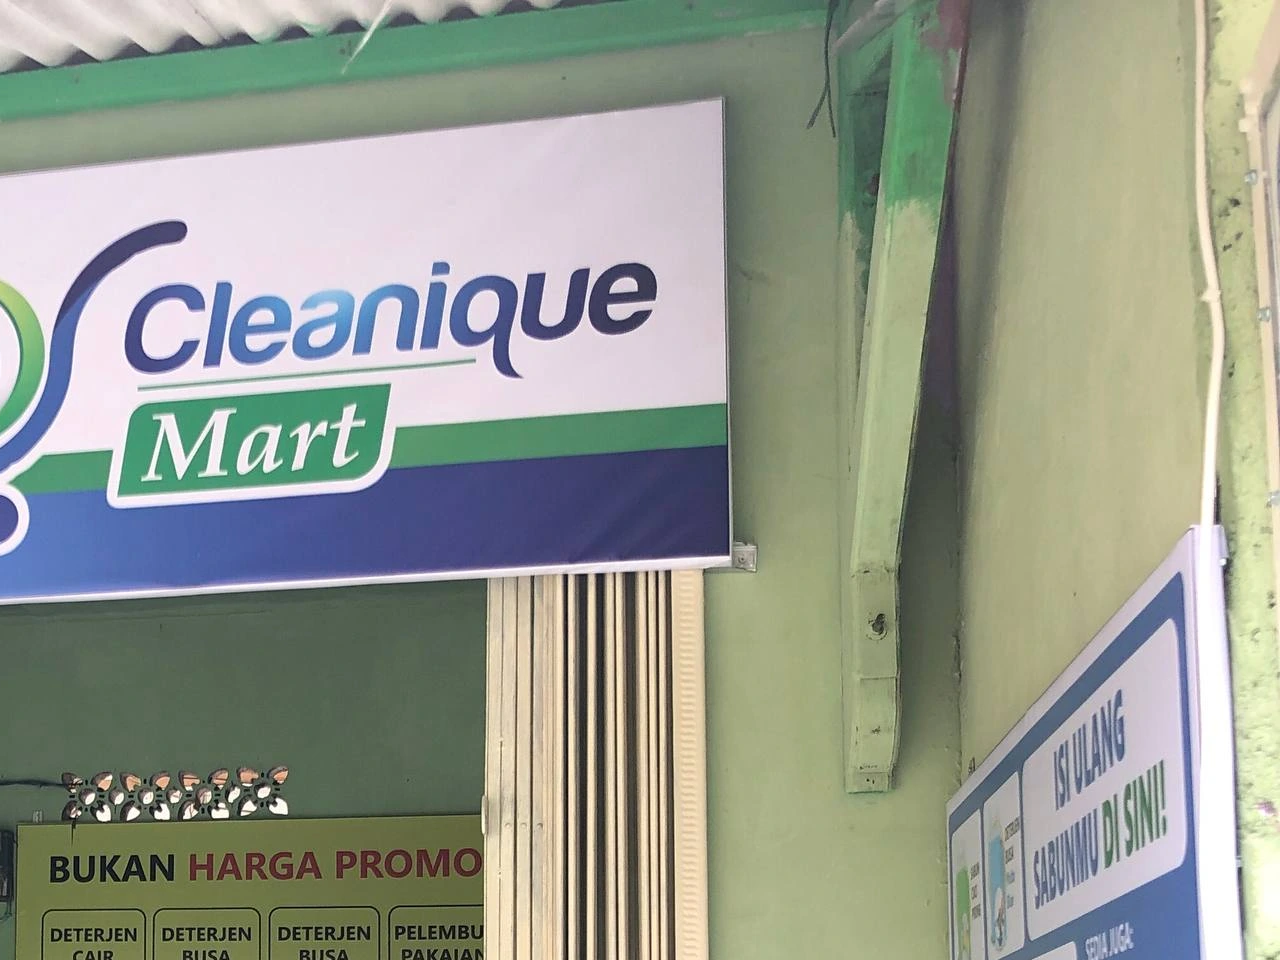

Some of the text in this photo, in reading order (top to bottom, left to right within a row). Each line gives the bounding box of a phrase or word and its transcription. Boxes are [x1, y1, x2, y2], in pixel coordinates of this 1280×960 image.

[125, 261, 657, 380] Cleanique
[140, 402, 364, 483] Mart
[1054, 689, 1125, 810] ISI ULANG
[49, 847, 483, 883] BUKAN HARGA PROMO
[1033, 808, 1099, 909] SABUNMU
[1102, 793, 1120, 870] DI
[50, 927, 138, 944] DETERJEN
[161, 926, 252, 943] DETERJEN
[277, 925, 371, 943] DETERJEN
